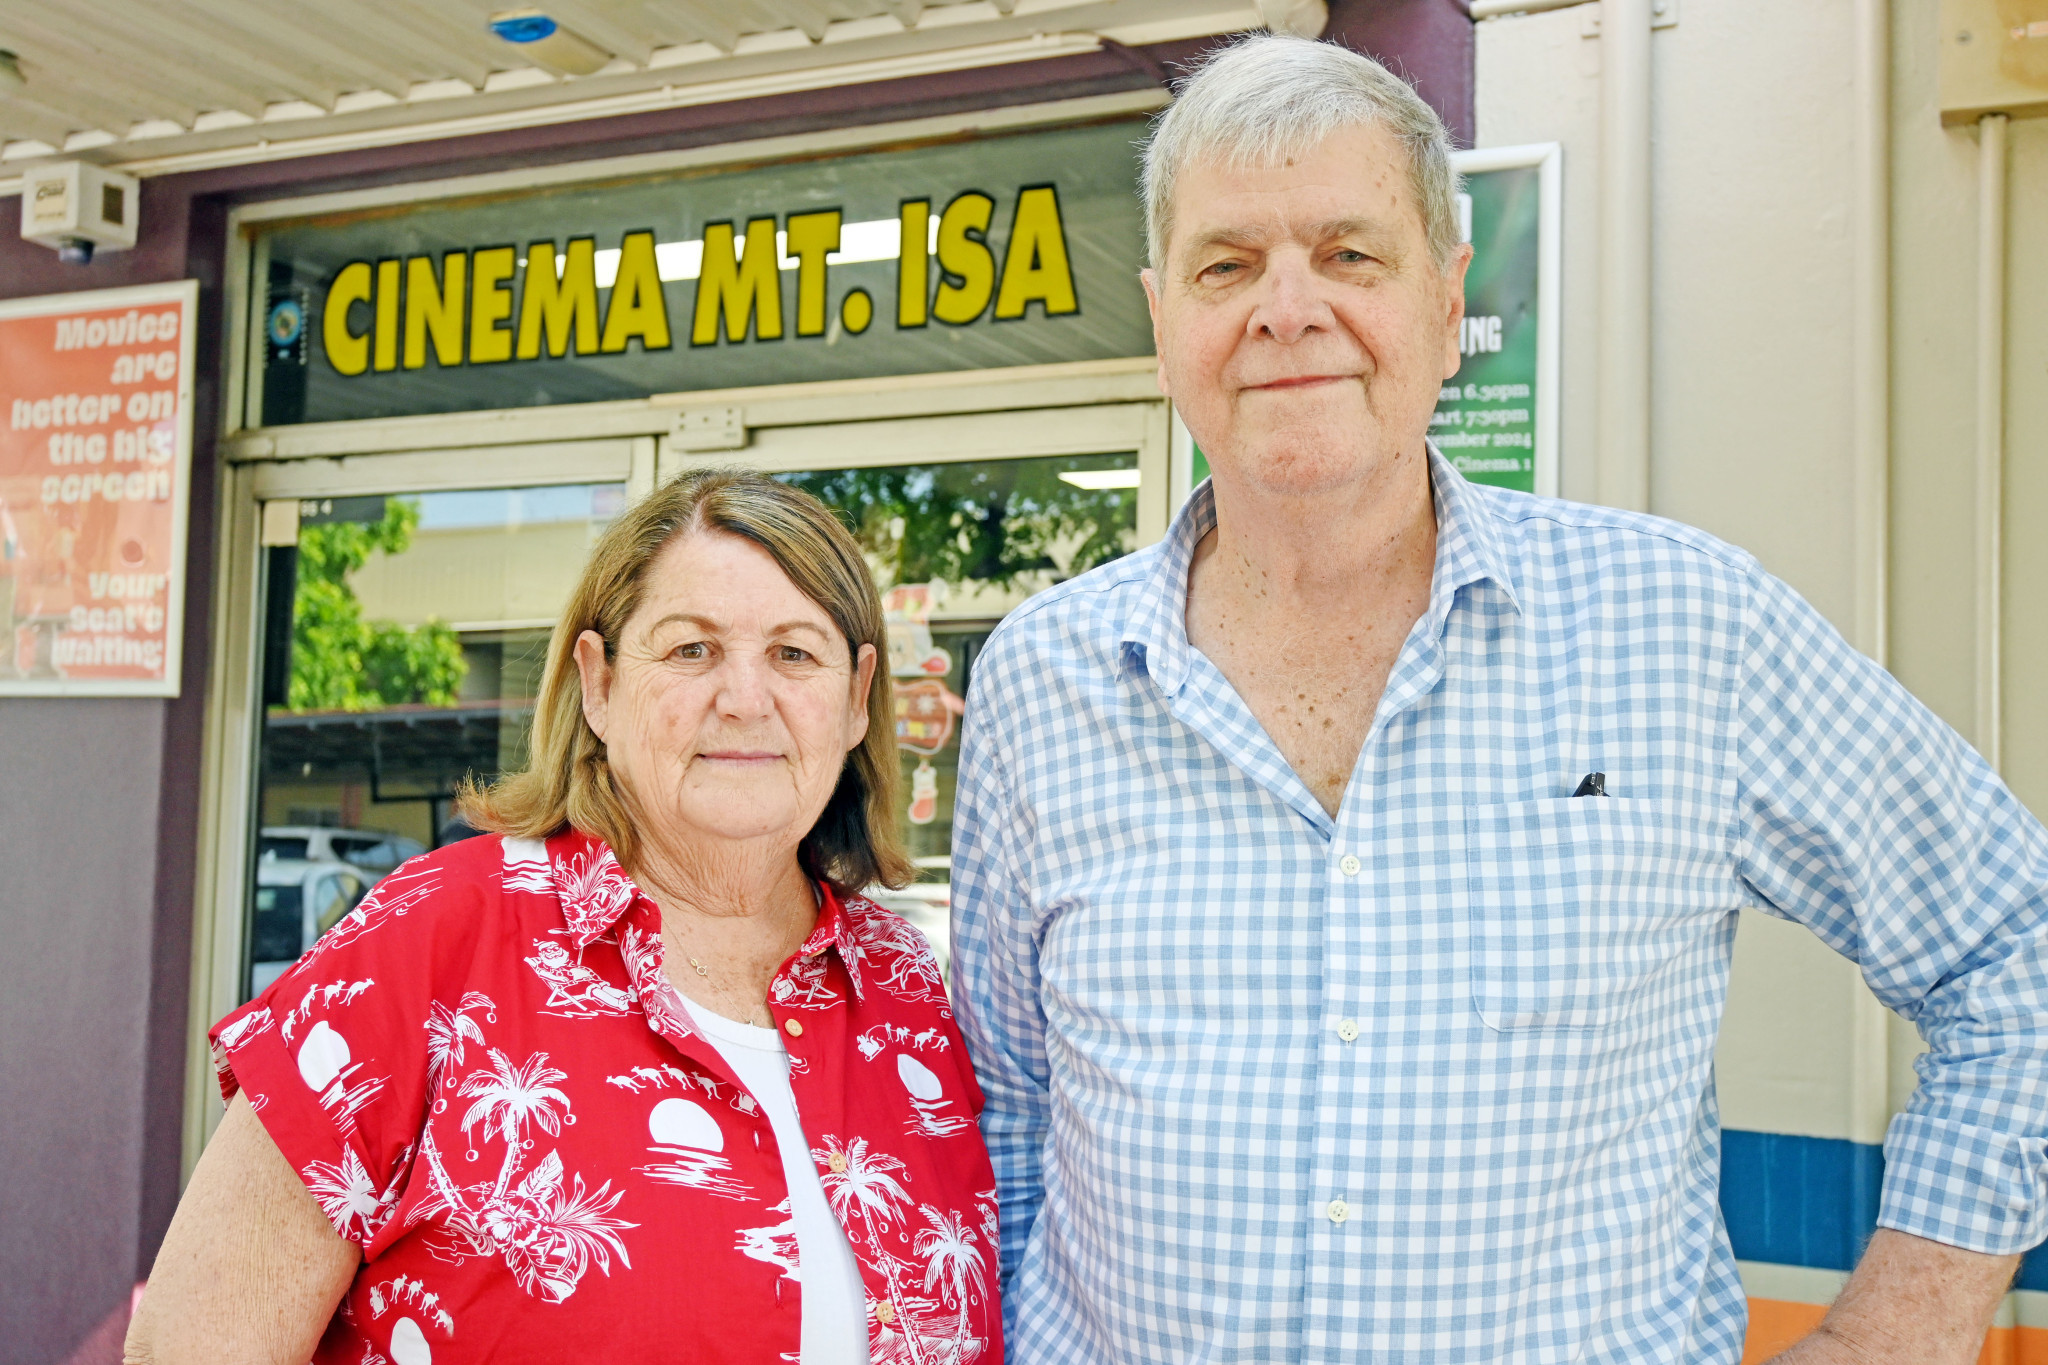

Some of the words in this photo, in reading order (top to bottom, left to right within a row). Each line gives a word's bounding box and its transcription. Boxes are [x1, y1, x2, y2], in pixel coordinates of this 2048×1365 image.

[322, 229, 672, 376] CINEMA
[691, 207, 874, 348] MT.
[896, 181, 1081, 331] ISA
[54, 310, 178, 351] Movies
[1459, 315, 1503, 357] ING
[110, 351, 177, 385] are
[1438, 386, 1461, 401] en
[1463, 383, 1530, 402] 6.30pm
[11, 393, 122, 431] better
[126, 390, 174, 422] on
[1428, 409, 1463, 426] art
[48, 432, 107, 466] the
[1429, 431, 1490, 448] ember
[1492, 432, 1532, 449] 2024
[1452, 456, 1520, 473] Cinema
[41, 469, 170, 503] screen
[88, 572, 167, 600] your
